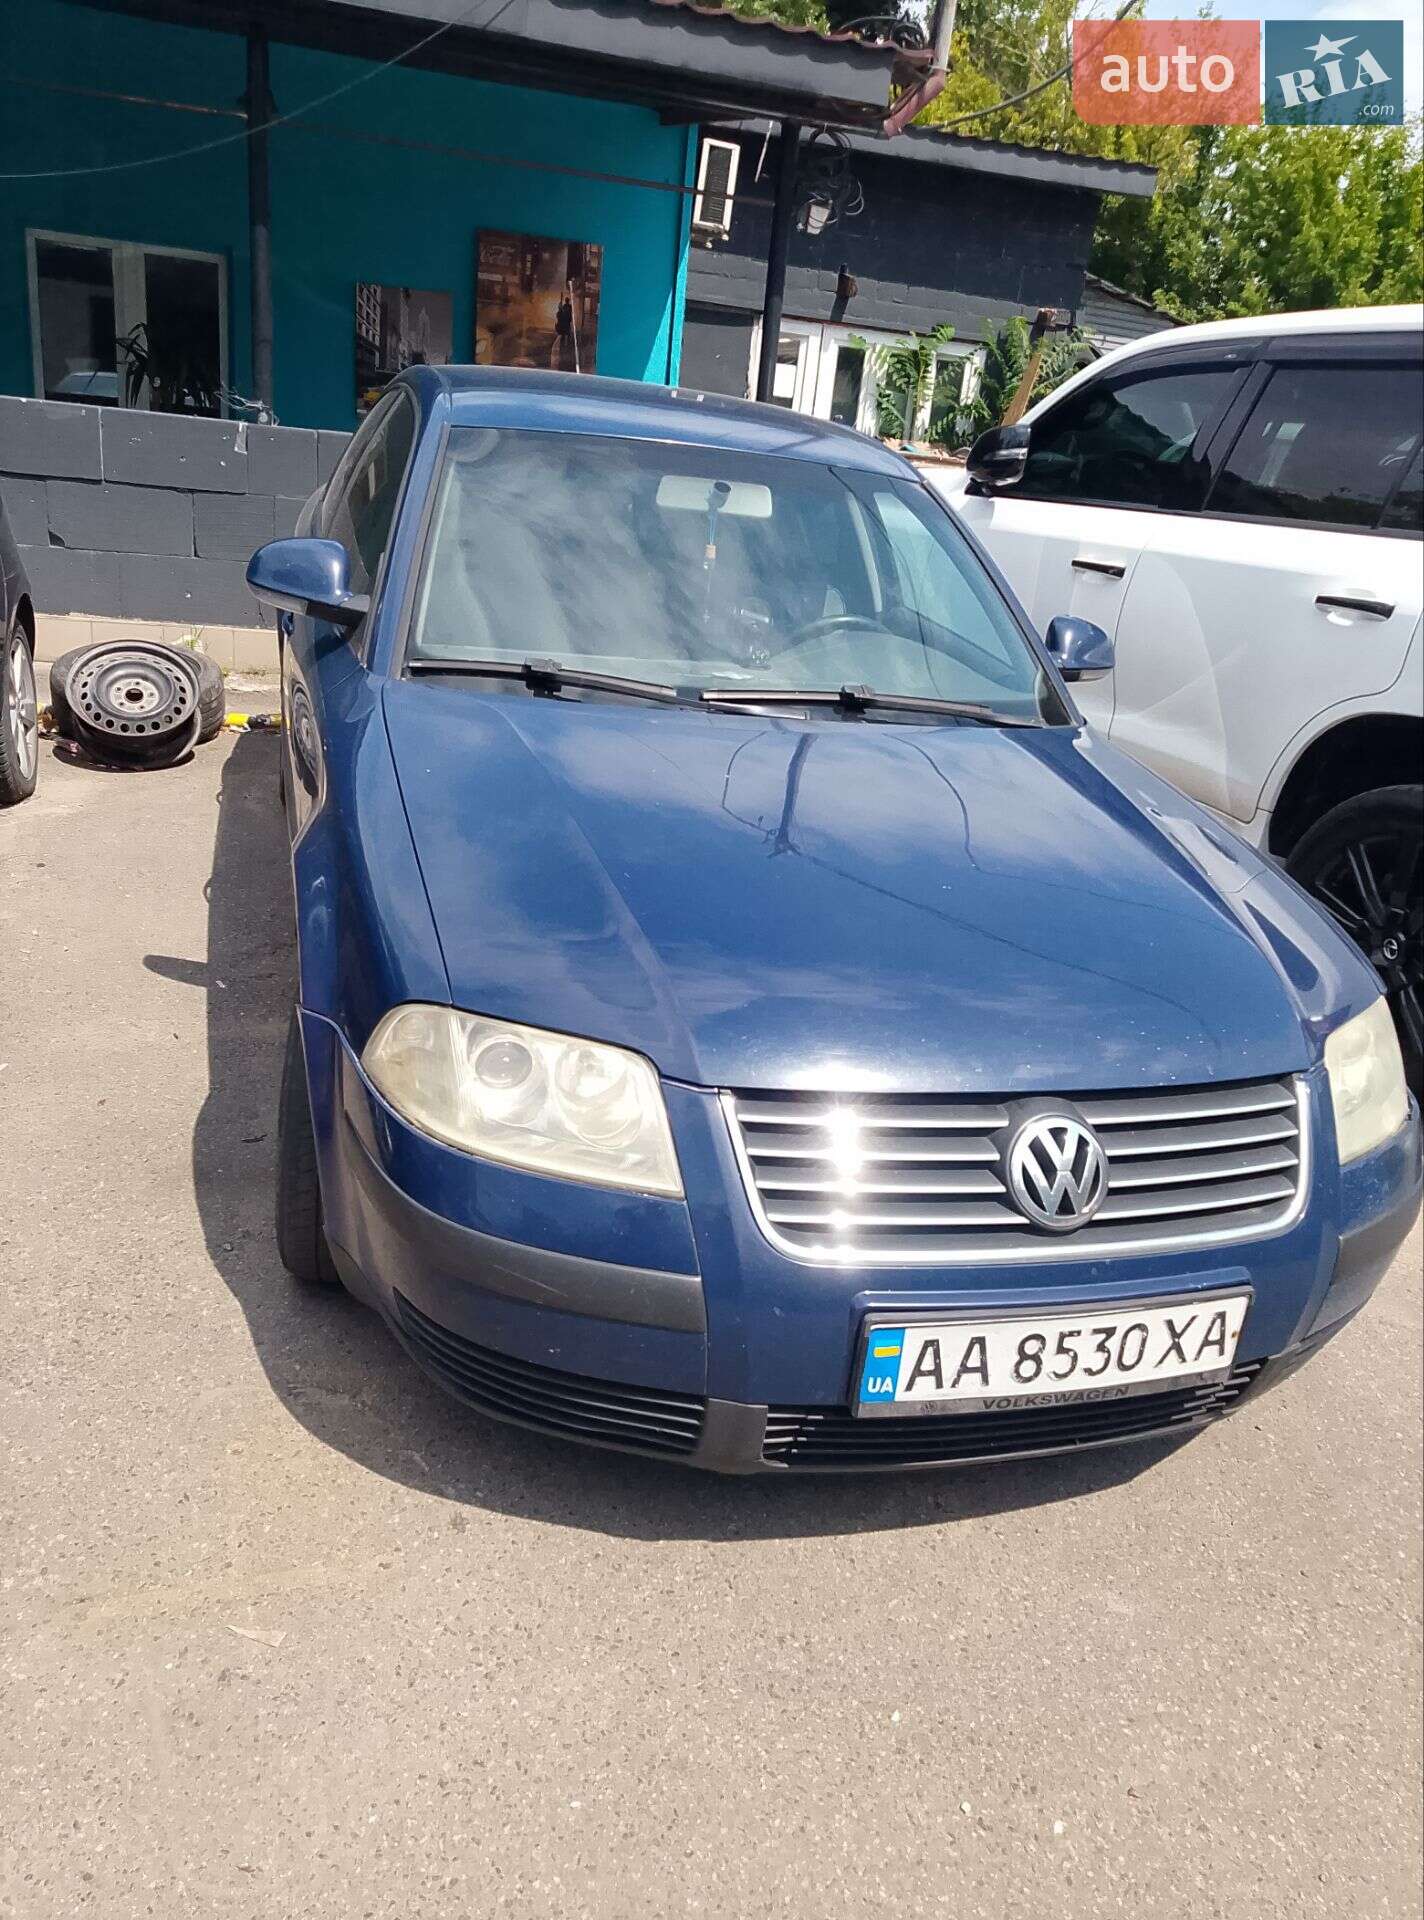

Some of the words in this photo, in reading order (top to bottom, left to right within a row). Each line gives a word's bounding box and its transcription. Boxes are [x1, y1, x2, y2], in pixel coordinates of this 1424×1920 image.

[903, 1337, 991, 1392] AA
[1012, 1322, 1149, 1384] 8530
[1153, 1311, 1228, 1369] XA
[867, 1377, 893, 1393] UA
[983, 1386, 1129, 1410] VOLKSWAGEN
